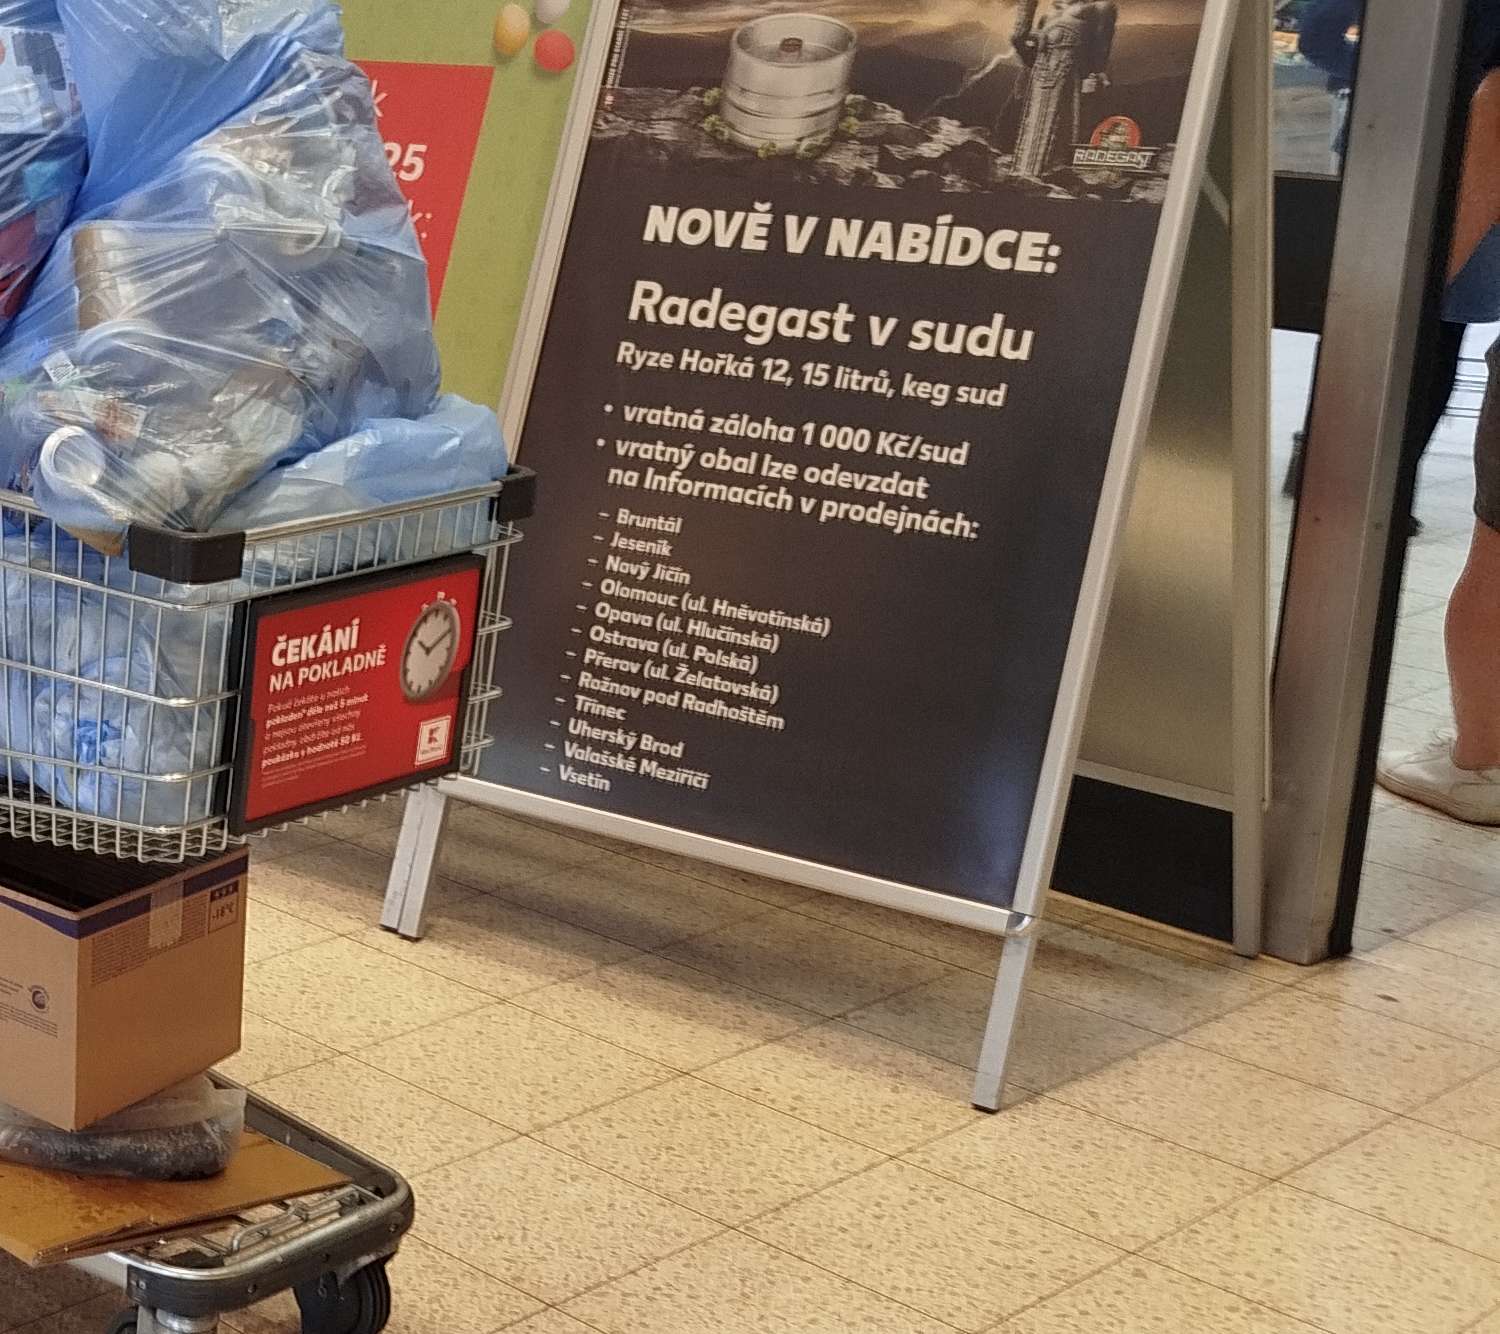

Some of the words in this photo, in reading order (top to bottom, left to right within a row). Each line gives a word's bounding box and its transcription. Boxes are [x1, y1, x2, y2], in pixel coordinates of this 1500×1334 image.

[1073, 148, 1156, 169] RADEGAST
[642, 201, 773, 252] NOVĚ
[784, 215, 819, 254] V
[824, 213, 1062, 274] NABÍDCE:
[628, 280, 856, 346] Radegast
[868, 315, 898, 347] v
[908, 312, 1035, 361] sudu
[616, 341, 674, 372] Ryze
[679, 349, 754, 379] Hořká
[761, 358, 794, 388] 12,
[802, 362, 830, 387] 15
[835, 366, 896, 400] litrů,
[901, 373, 951, 407] keg
[955, 382, 1009, 408] sud
[623, 405, 705, 432] vratná
[709, 414, 796, 444] záloha
[876, 430, 971, 466] Kč/sud
[615, 436, 695, 468] vratný
[699, 448, 757, 477] obal
[760, 454, 799, 481] lze
[803, 465, 931, 501] odevzdat
[607, 467, 640, 489] na
[643, 467, 795, 512] Informacích
[800, 496, 817, 514] v
[819, 496, 980, 540] prodejnách:
[616, 508, 683, 534] Bruntál
[605, 554, 650, 580] Nový
[652, 563, 692, 585] Jičín
[610, 532, 673, 557] Jeseník
[594, 601, 653, 629] Opava
[655, 612, 683, 634] (ul.
[686, 620, 781, 654] Hlučínská)
[600, 578, 680, 608] Olomouc
[681, 592, 708, 613] (ul.
[712, 598, 832, 638] Hněvotínská)
[271, 617, 361, 667] ČEKÁNÍ
[583, 648, 642, 674] Přerov
[644, 659, 670, 681] (ul.
[589, 625, 660, 653] Ostrava
[662, 638, 689, 660] (ul.
[693, 645, 759, 676] Polská)
[268, 670, 294, 693] NA
[297, 644, 388, 686] POKLADNĚ
[575, 694, 628, 721] Třinec
[578, 671, 642, 700] Rožnov
[642, 690, 680, 707] pod
[681, 693, 786, 732] Radhoštěm
[564, 740, 637, 773] Valašské
[568, 717, 639, 751] Uherský
[639, 733, 685, 759] Brod
[559, 764, 611, 793] Vsetín
